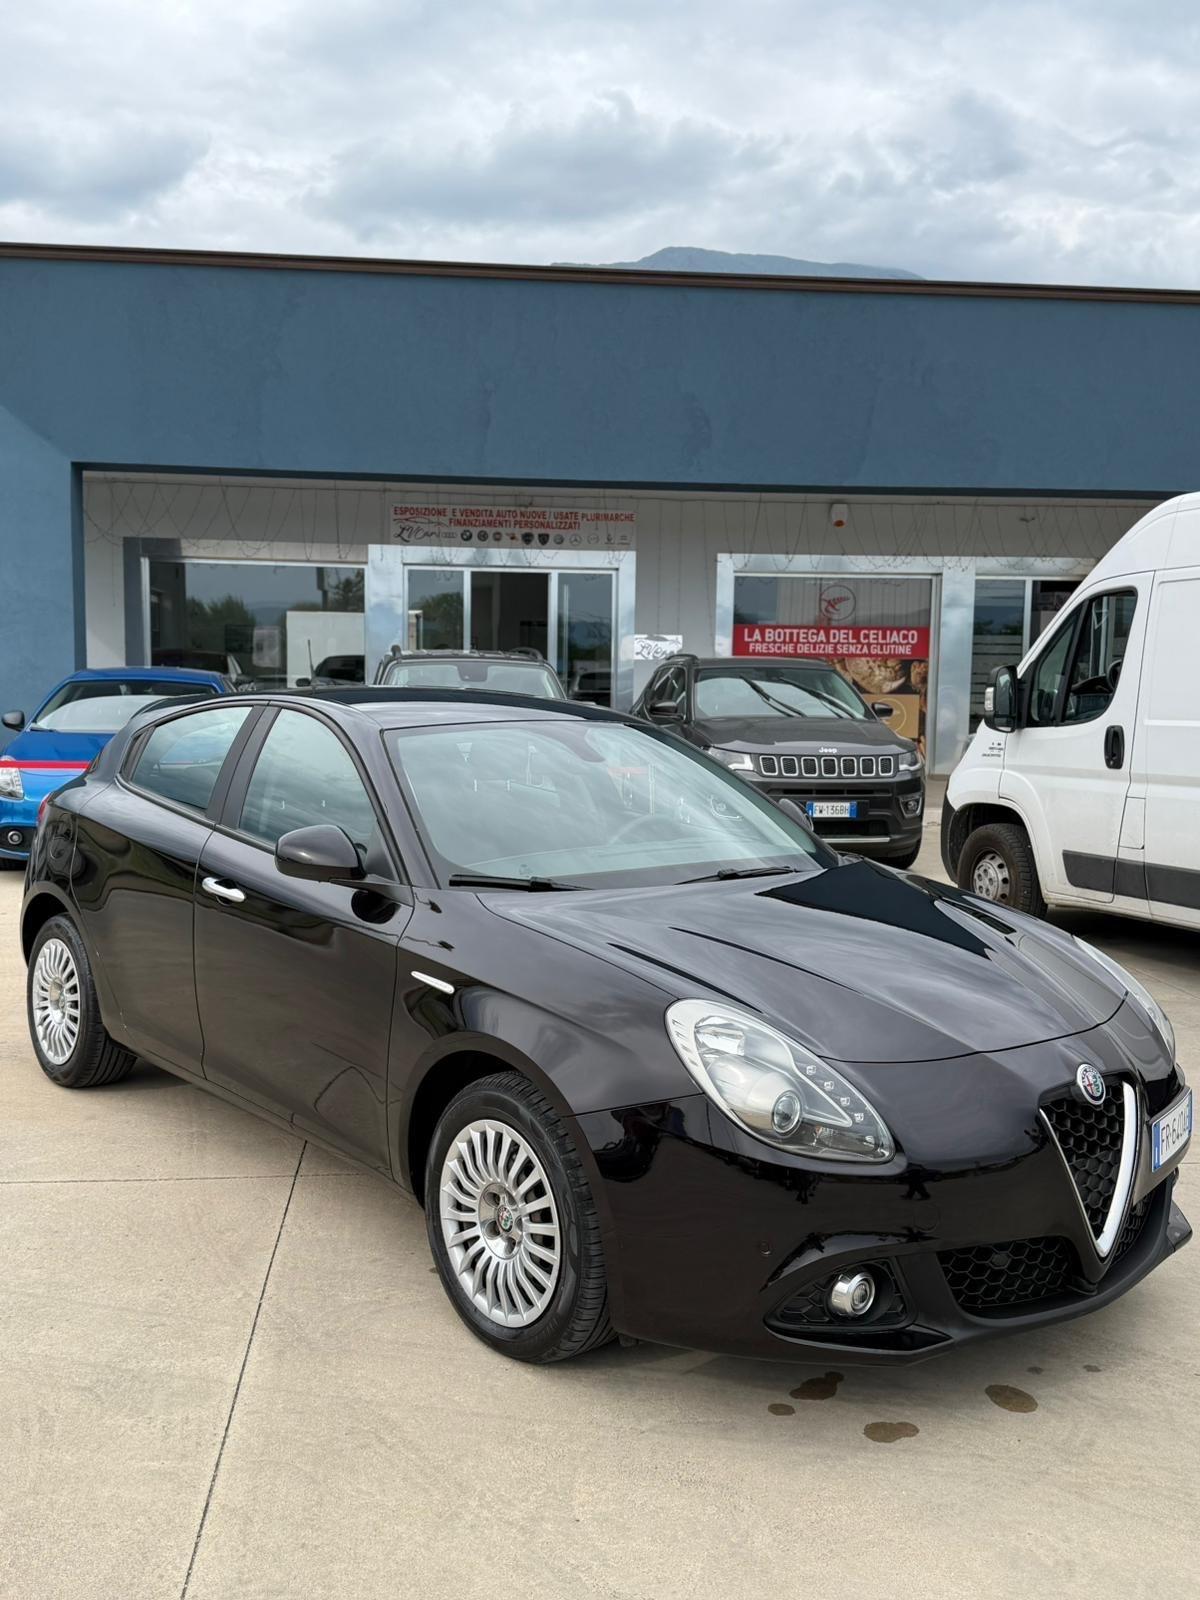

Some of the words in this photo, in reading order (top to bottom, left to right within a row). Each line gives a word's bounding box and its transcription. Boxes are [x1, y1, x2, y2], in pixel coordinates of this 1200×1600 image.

[394, 507, 447, 517] ESPOSIZIONE
[452, 508, 457, 518] E
[459, 509, 494, 518] VENDITA
[496, 509, 518, 520] AUTO
[520, 511, 547, 520] NUOVE
[554, 512, 579, 520] USATE
[581, 513, 635, 522] PLURIMARCHE
[449, 518, 511, 529] FINANZIAMENTI
[513, 519, 581, 529] PERSONALIZZATI
[744, 628, 762, 642] LA
[765, 628, 826, 643] BOTTEGA
[830, 629, 856, 643] DEL
[860, 630, 918, 644] CELIACO
[749, 643, 794, 653] FRESCHE
[797, 644, 834, 654] DELIZIE
[837, 645, 868, 654] SENZA
[870, 645, 912, 655] GLUTINE
